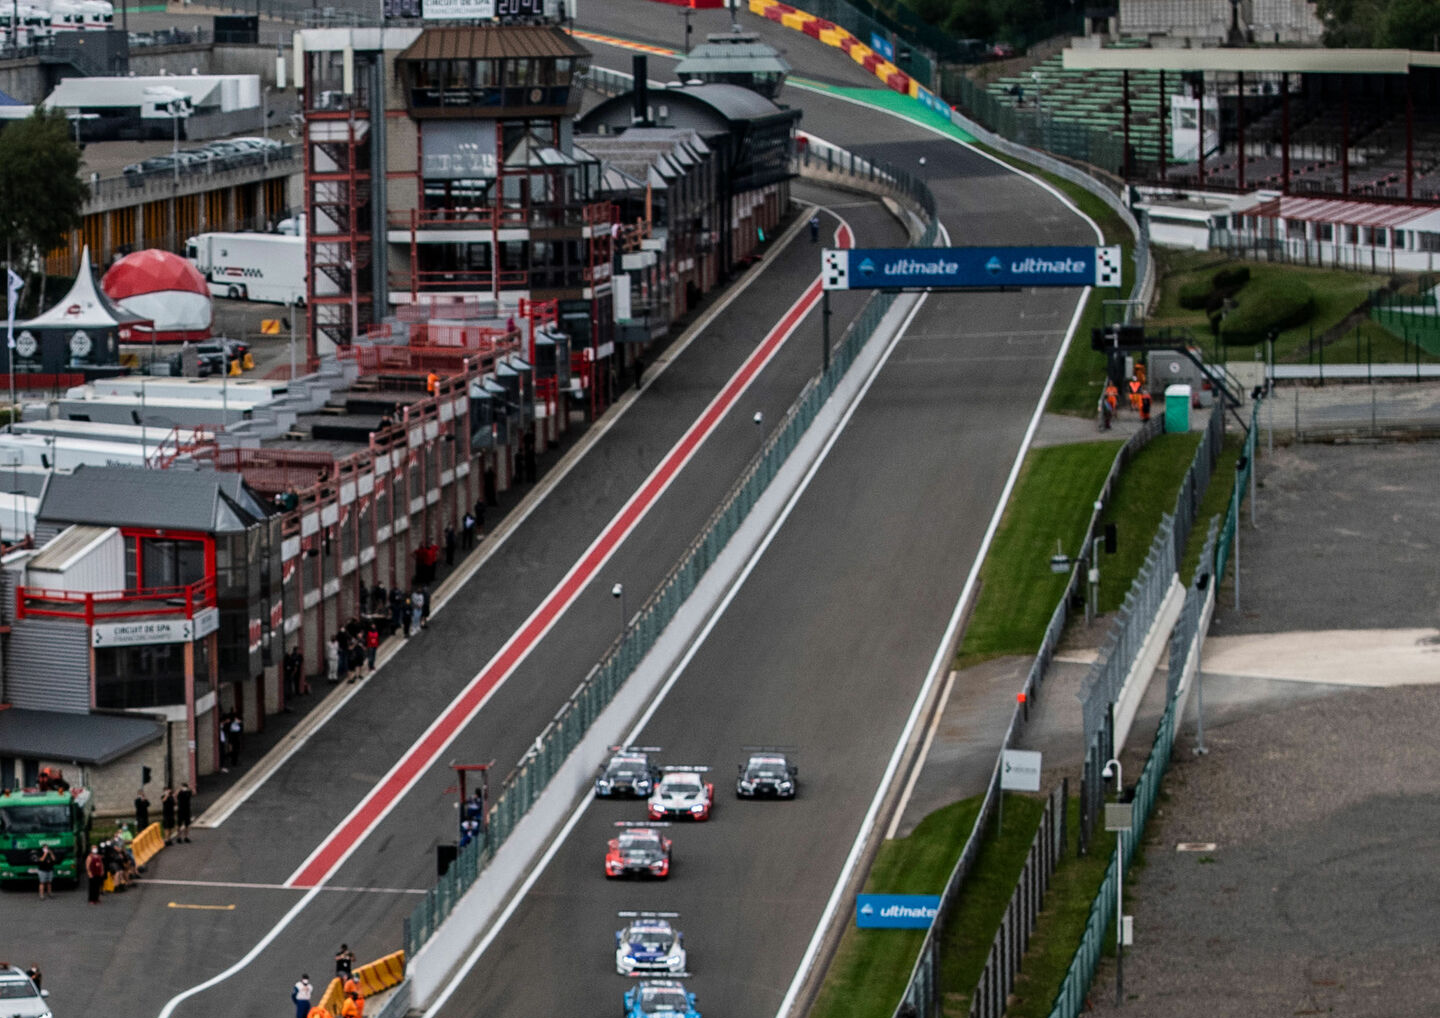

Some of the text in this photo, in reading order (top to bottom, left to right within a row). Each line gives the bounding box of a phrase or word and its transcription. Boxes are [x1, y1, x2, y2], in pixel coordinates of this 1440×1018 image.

[884, 260, 959, 275] ultimate
[1011, 258, 1086, 273] ultimate
[113, 624, 171, 635] CIRCUIT DE SPA
[880, 905, 938, 918] ultimate
